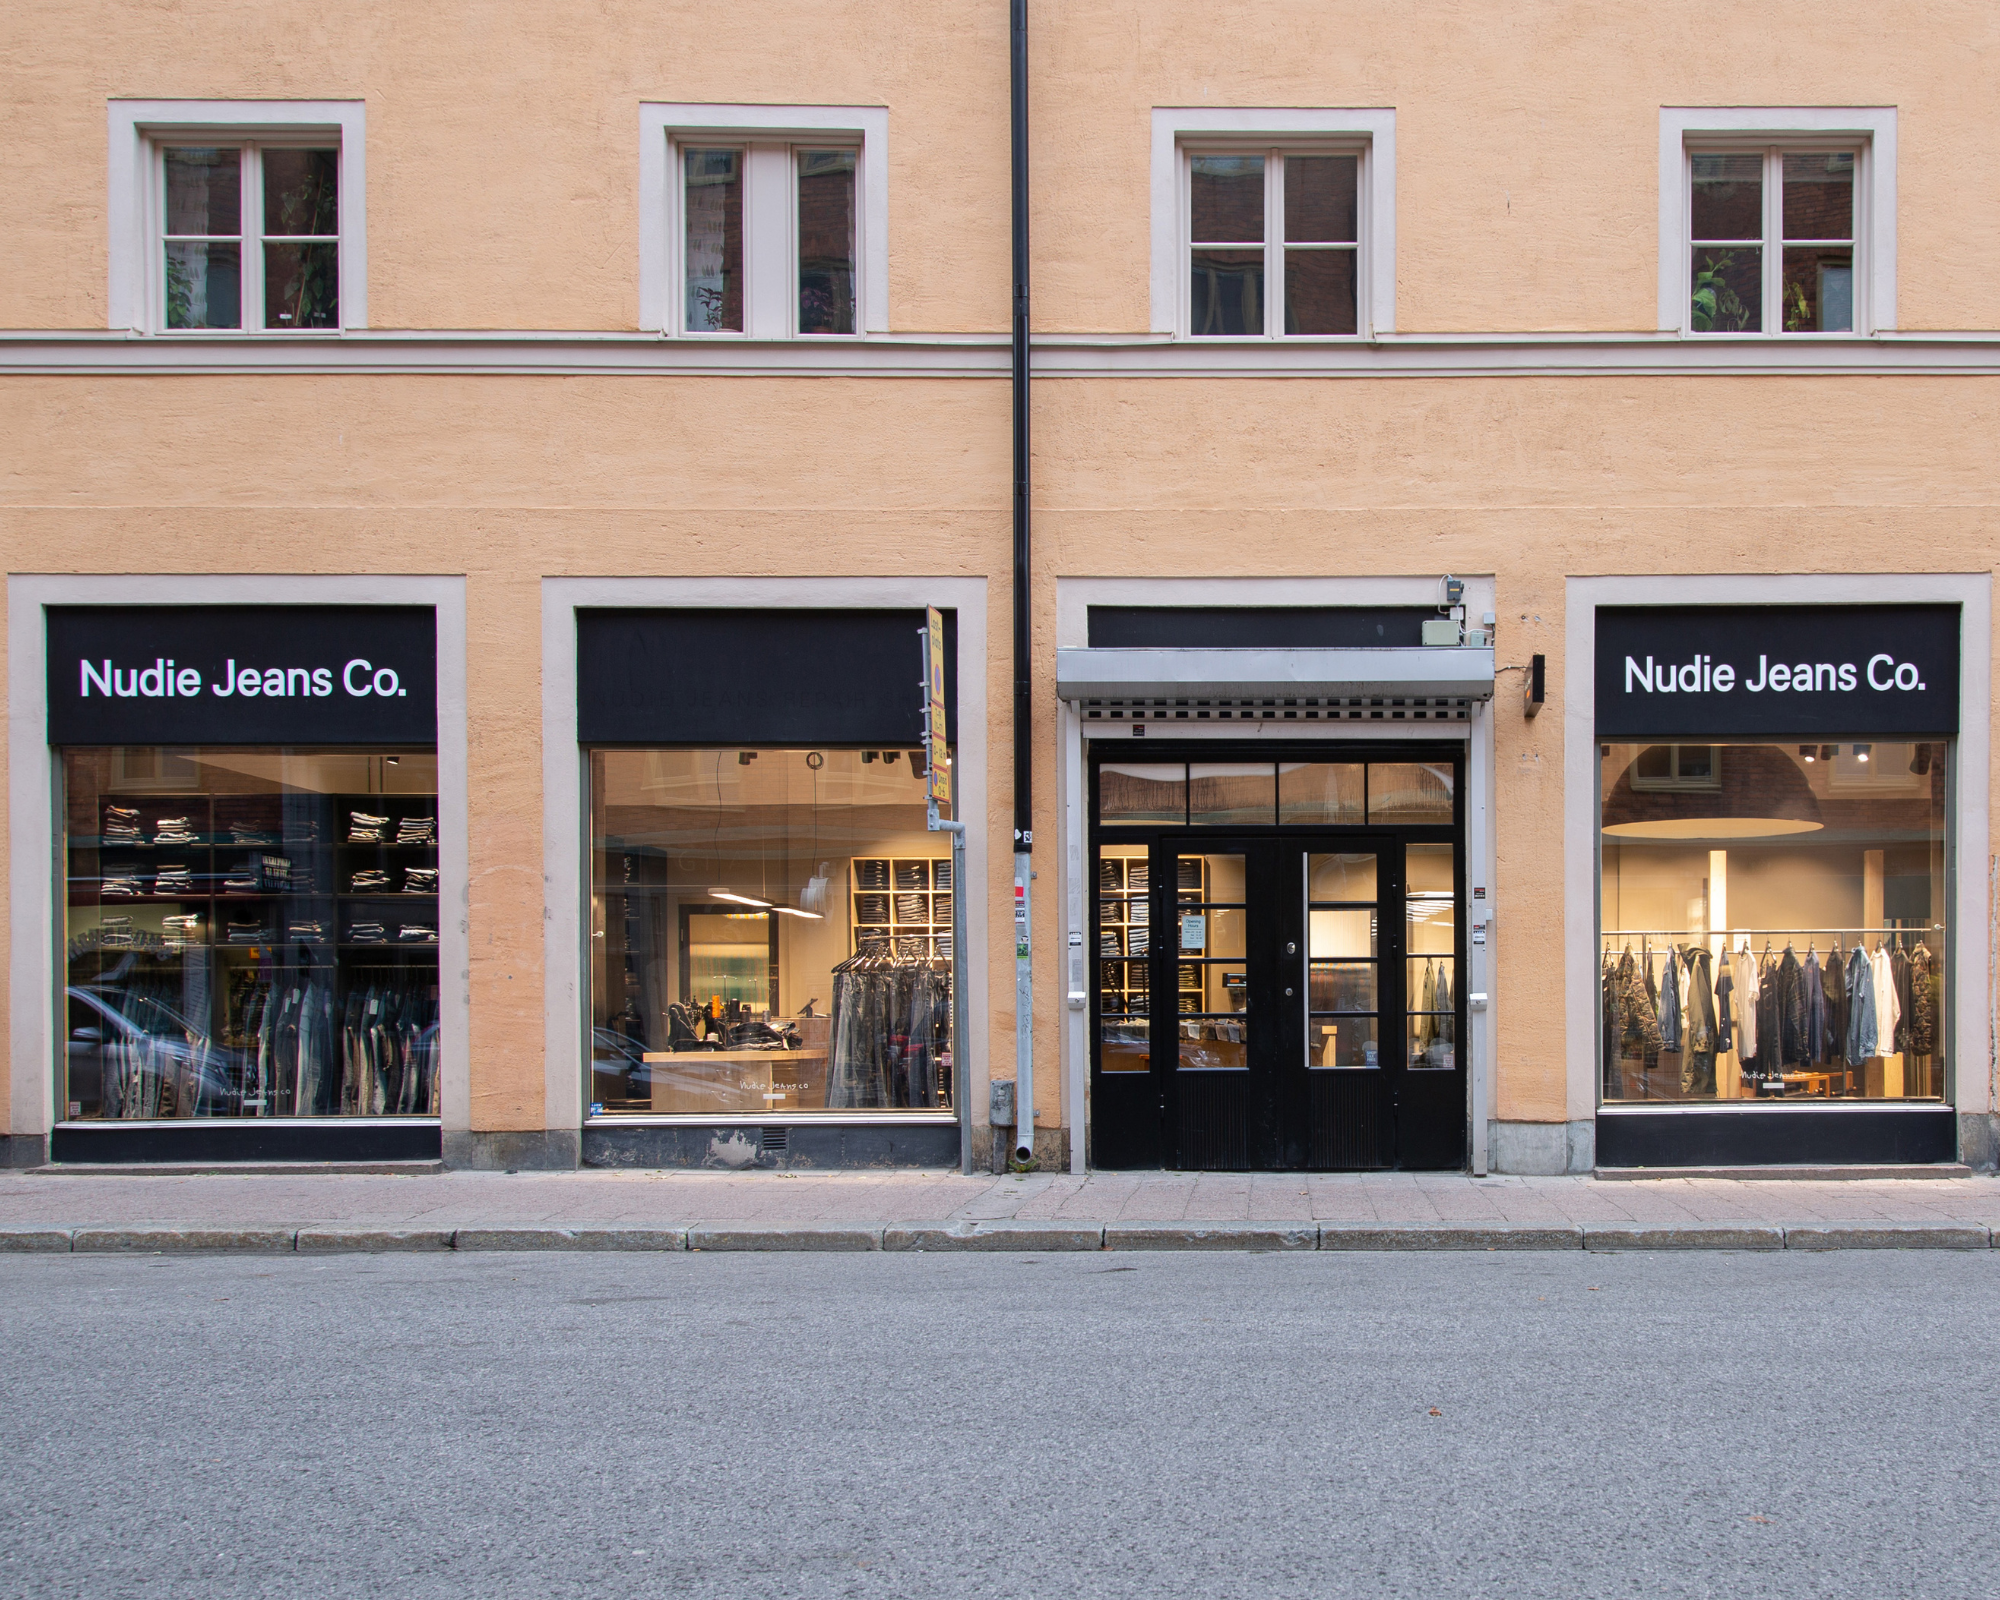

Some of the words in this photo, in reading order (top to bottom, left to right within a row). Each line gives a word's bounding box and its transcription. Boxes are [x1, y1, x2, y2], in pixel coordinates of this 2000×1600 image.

[80, 658, 201, 698] Nudie
[212, 658, 333, 698] Jeans
[343, 658, 407, 697] Co.
[1625, 654, 1736, 693] Nudie
[1745, 654, 1858, 693] Jeans
[1867, 653, 1926, 691] Co.
[687, 690, 768, 708] JEANS
[784, 690, 867, 708] REPAIR
